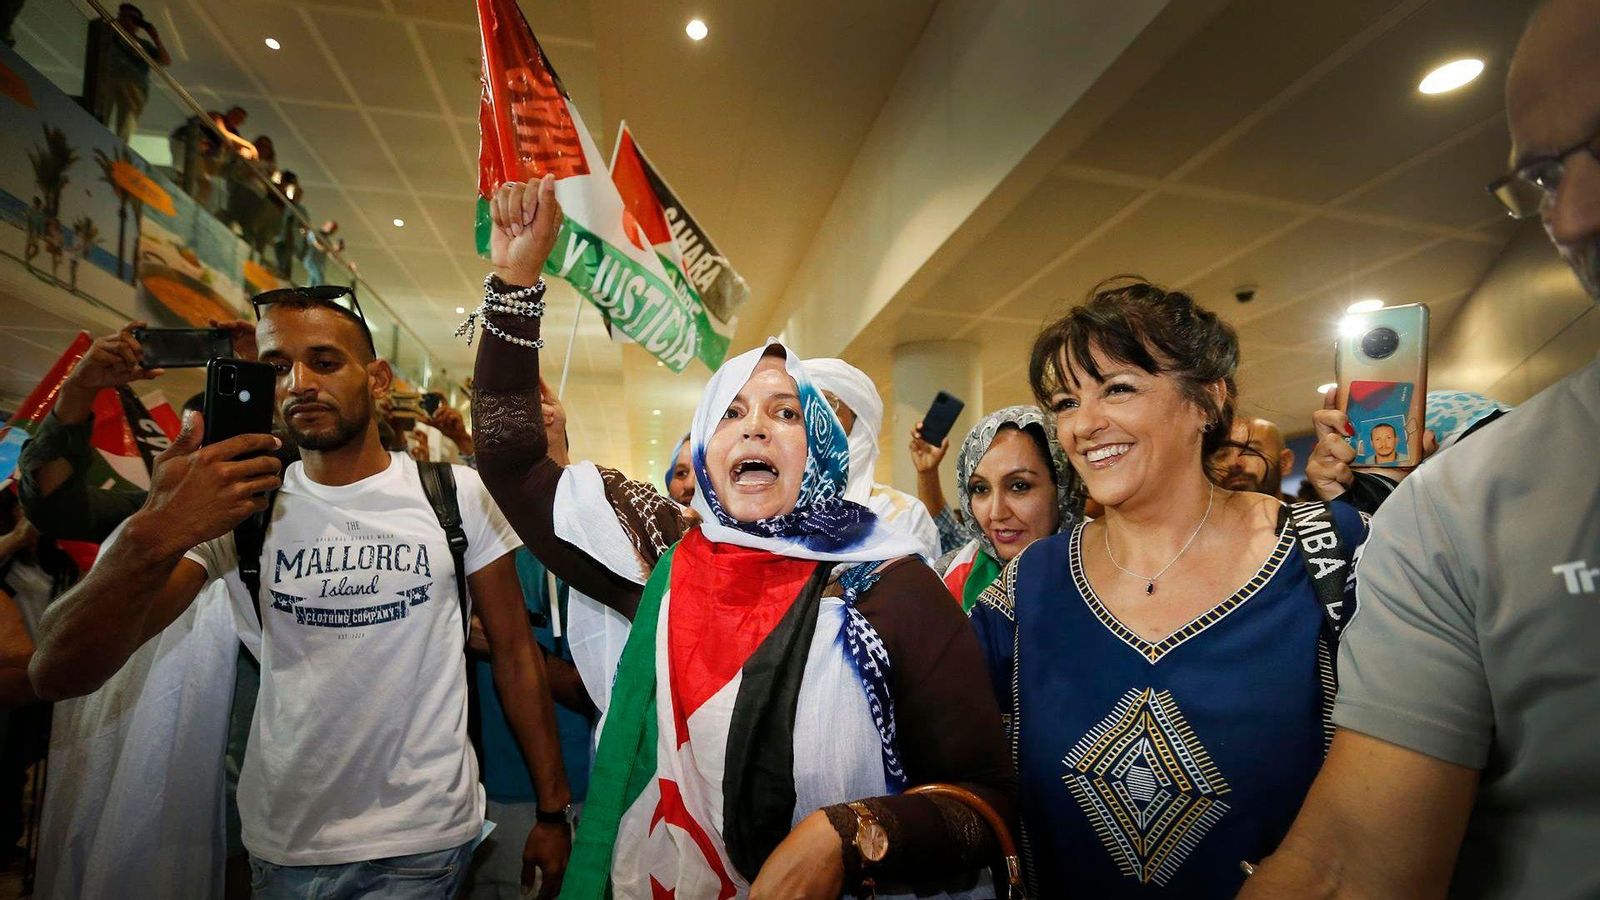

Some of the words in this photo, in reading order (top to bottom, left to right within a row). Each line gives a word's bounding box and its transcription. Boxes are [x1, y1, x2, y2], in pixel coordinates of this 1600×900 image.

[664, 206, 722, 293] SAHARA
[561, 235, 589, 278] Y
[591, 256, 698, 370] JUSTICIA
[346, 521, 360, 531] THE
[274, 543, 432, 584] MALLORCA
[318, 574, 380, 599] Island
[306, 611, 350, 625] CLOTHING
[352, 608, 396, 623] COMPANY
